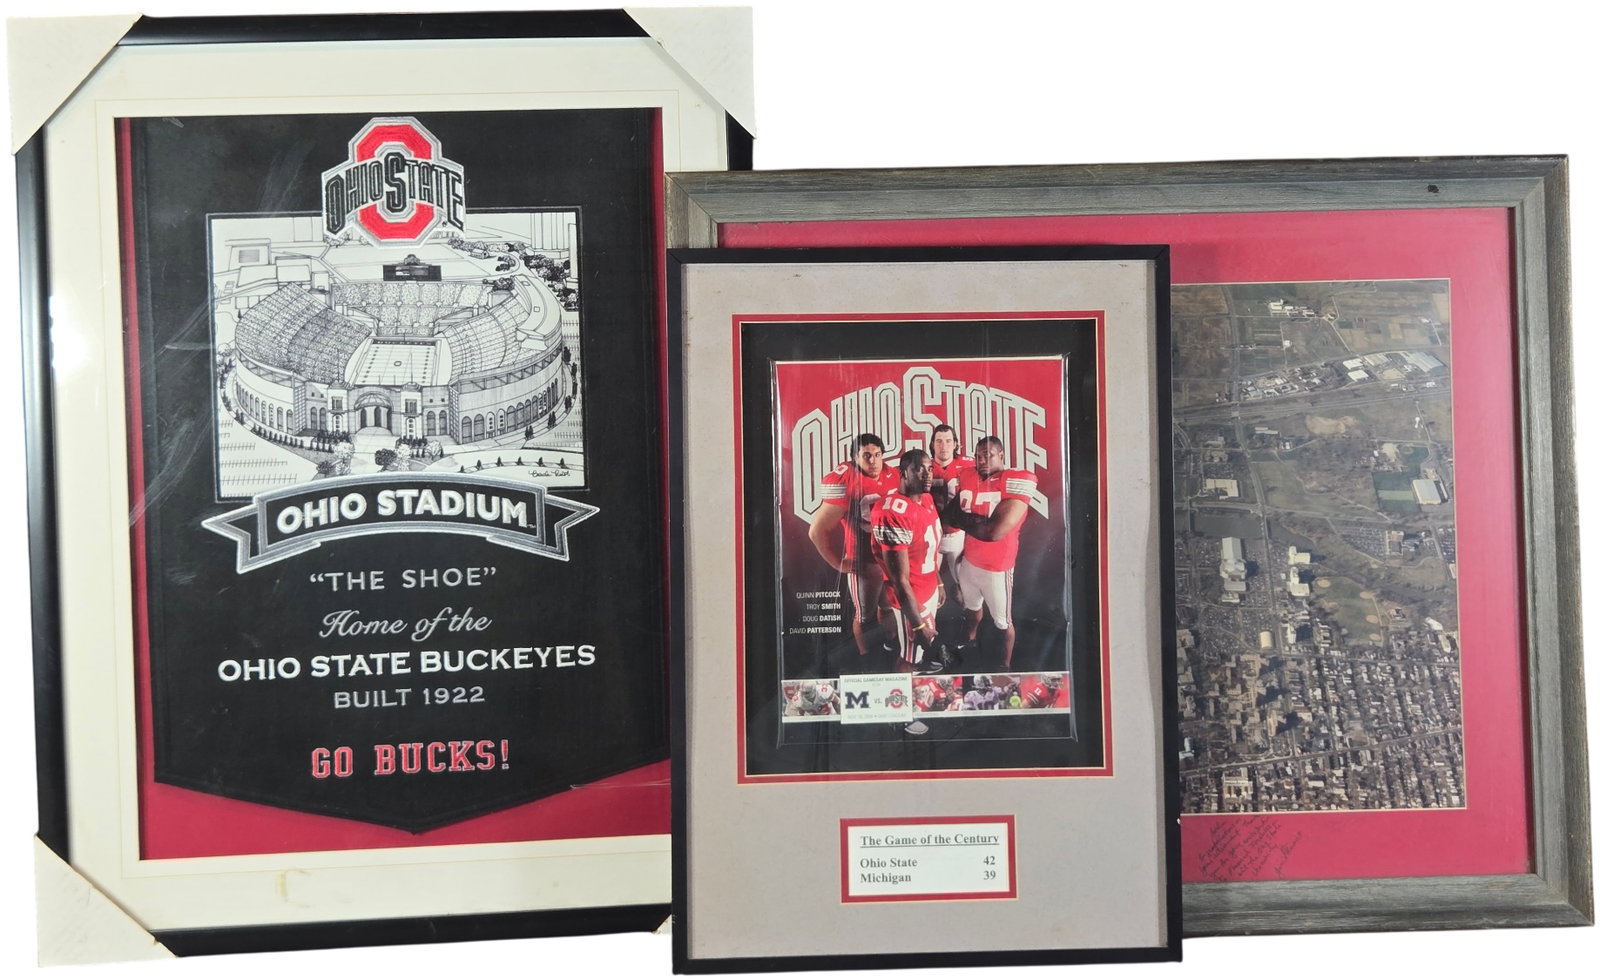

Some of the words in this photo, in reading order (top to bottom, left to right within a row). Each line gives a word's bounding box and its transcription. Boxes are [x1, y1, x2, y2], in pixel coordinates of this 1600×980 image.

[325, 159, 384, 235] OHIO
[383, 152, 464, 233] STATE
[792, 381, 901, 525] OHIO
[903, 366, 1049, 519] STATE
[277, 492, 367, 534] OHIO
[376, 489, 527, 528] STADIUM
[882, 497, 908, 514] 10
[319, 609, 407, 638] Home
[411, 607, 449, 641] of
[448, 607, 492, 632] the
[819, 614, 842, 622] DATISH
[789, 627, 806, 635] DAVID
[807, 626, 842, 634] PATTERSON
[217, 656, 301, 683] OHIO
[310, 651, 411, 678] STATE
[420, 645, 597, 674] BUCKEYES
[333, 688, 412, 709] BUILT
[423, 686, 486, 705] 1922
[845, 691, 869, 709] M
[311, 746, 354, 779] GO
[374, 739, 510, 776] BUCKS!
[860, 835, 882, 846] The
[885, 834, 918, 846] Game
[920, 834, 933, 845] of
[934, 834, 951, 845] the
[954, 833, 1000, 845] Century
[860, 858, 887, 868] Ohio
[890, 857, 918, 867] State
[983, 856, 996, 866] 42
[860, 873, 912, 885] Michigan
[983, 870, 996, 880] 39
